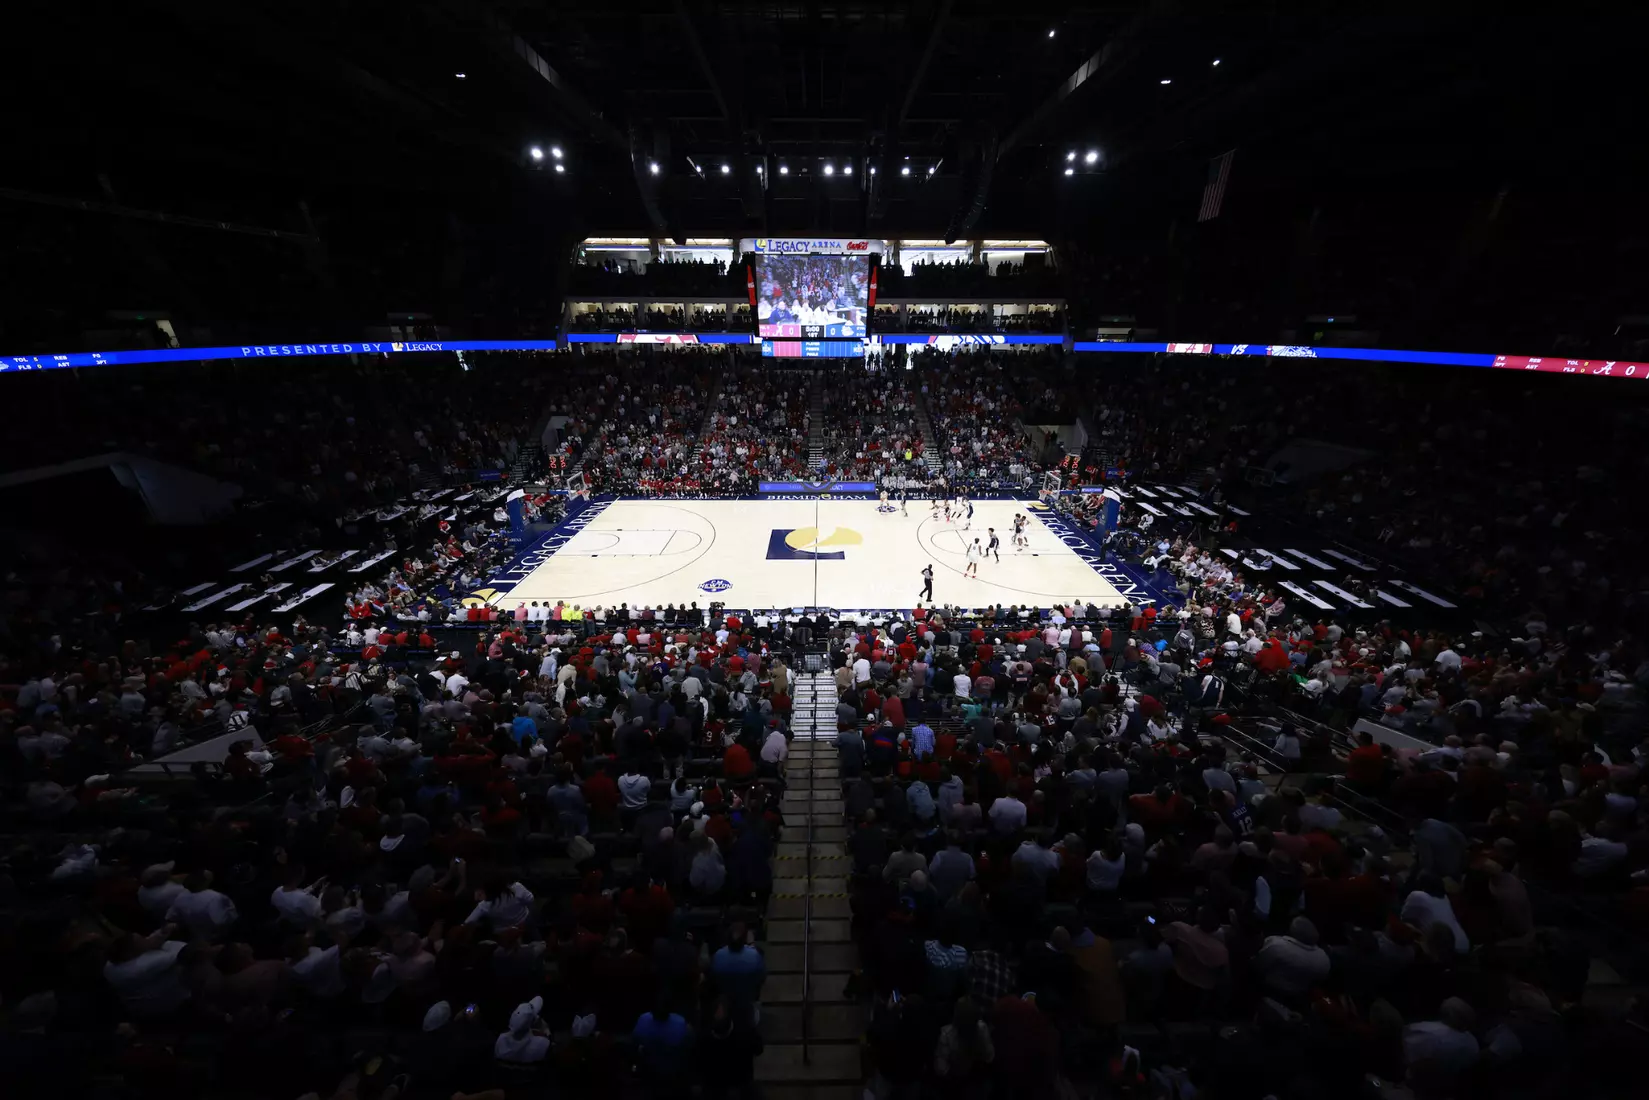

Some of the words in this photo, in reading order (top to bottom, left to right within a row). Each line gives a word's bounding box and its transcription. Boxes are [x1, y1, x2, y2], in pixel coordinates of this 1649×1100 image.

[768, 240, 811, 252] LEGACY
[789, 327, 794, 335] 0
[830, 327, 836, 335] 0
[242, 344, 353, 357] PRESENTED
[362, 343, 381, 352] BY
[405, 342, 443, 351] LEGACY
[1231, 344, 1249, 355] VS
[1624, 365, 1636, 376] 0
[487, 533, 575, 585] LEGACY
[563, 501, 613, 532] ARENA
[1031, 511, 1095, 555] LEGACY
[1079, 554, 1157, 605] ARENA
[1239, 815, 1255, 837] 12
